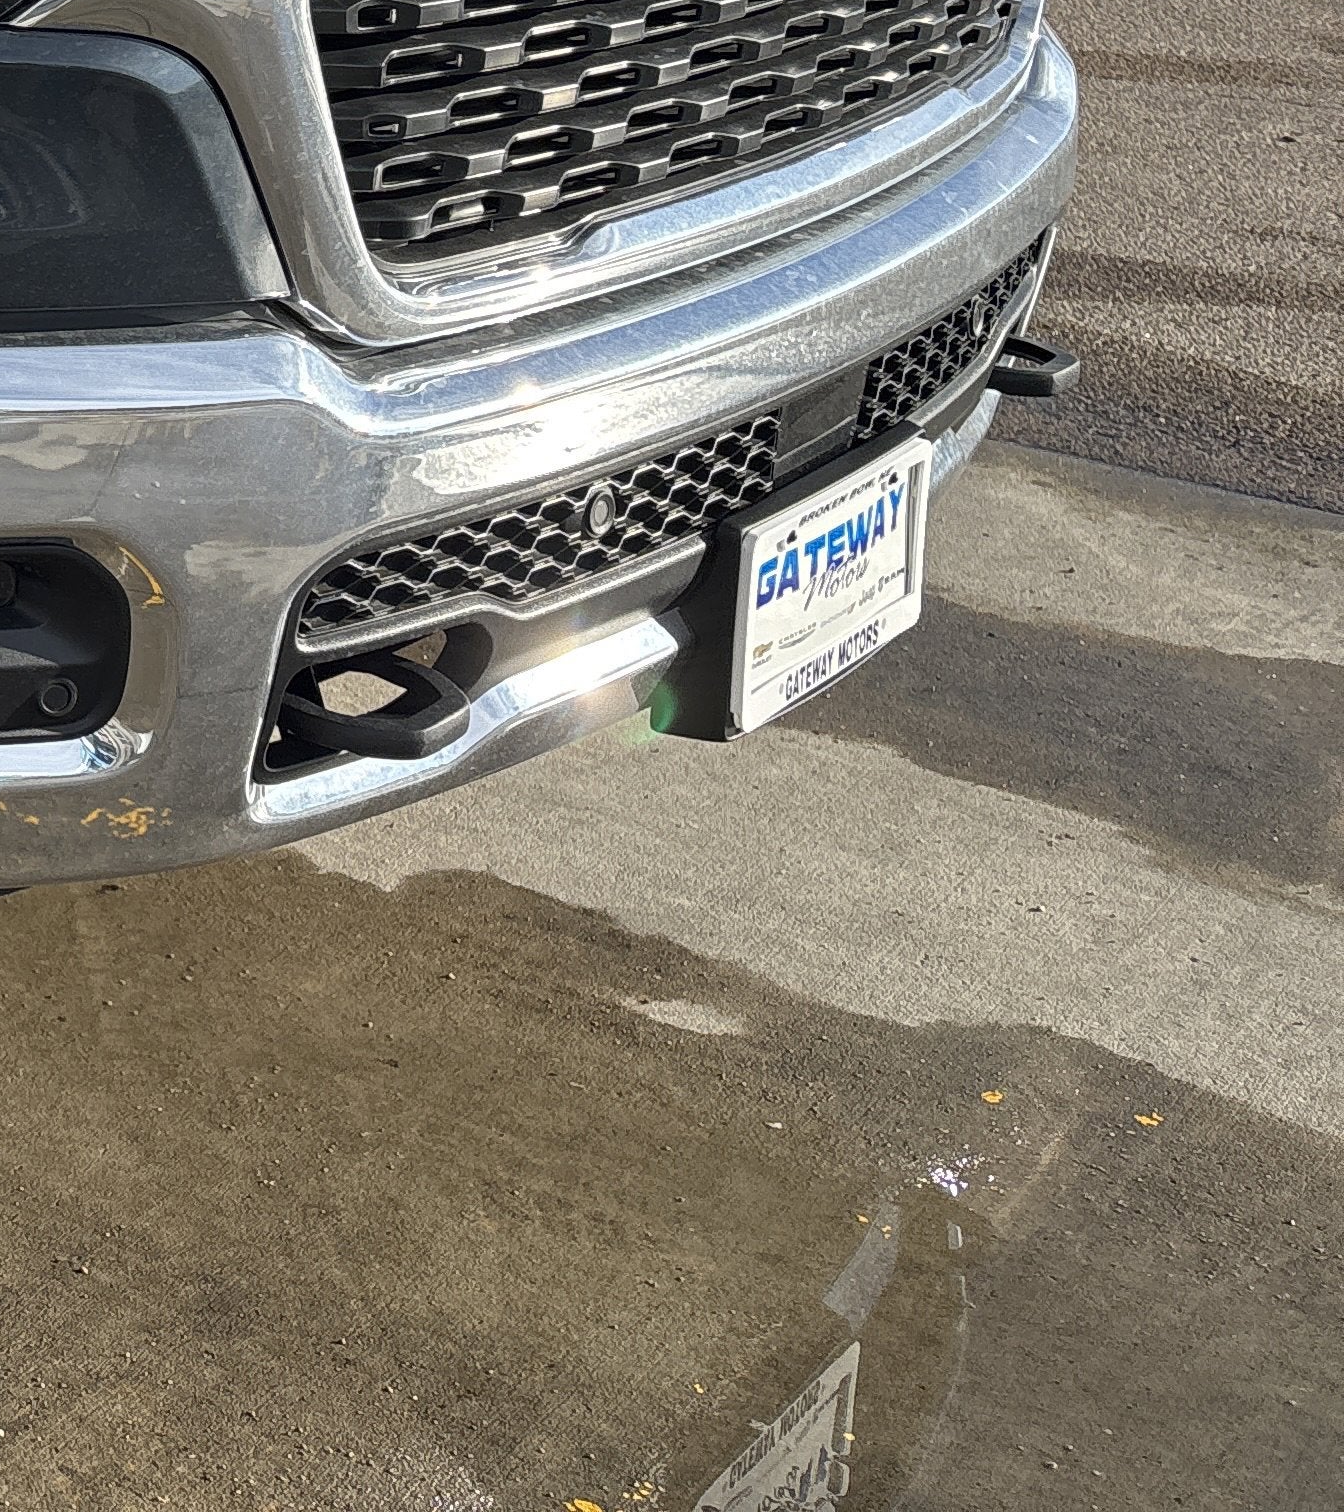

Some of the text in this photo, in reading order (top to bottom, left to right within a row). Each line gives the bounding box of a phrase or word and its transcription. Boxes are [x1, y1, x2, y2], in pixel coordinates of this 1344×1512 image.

[756, 482, 906, 611] GATEWAY
[799, 492, 848, 528] BROKEN
[785, 618, 880, 701] GATEWAY MOTORS
